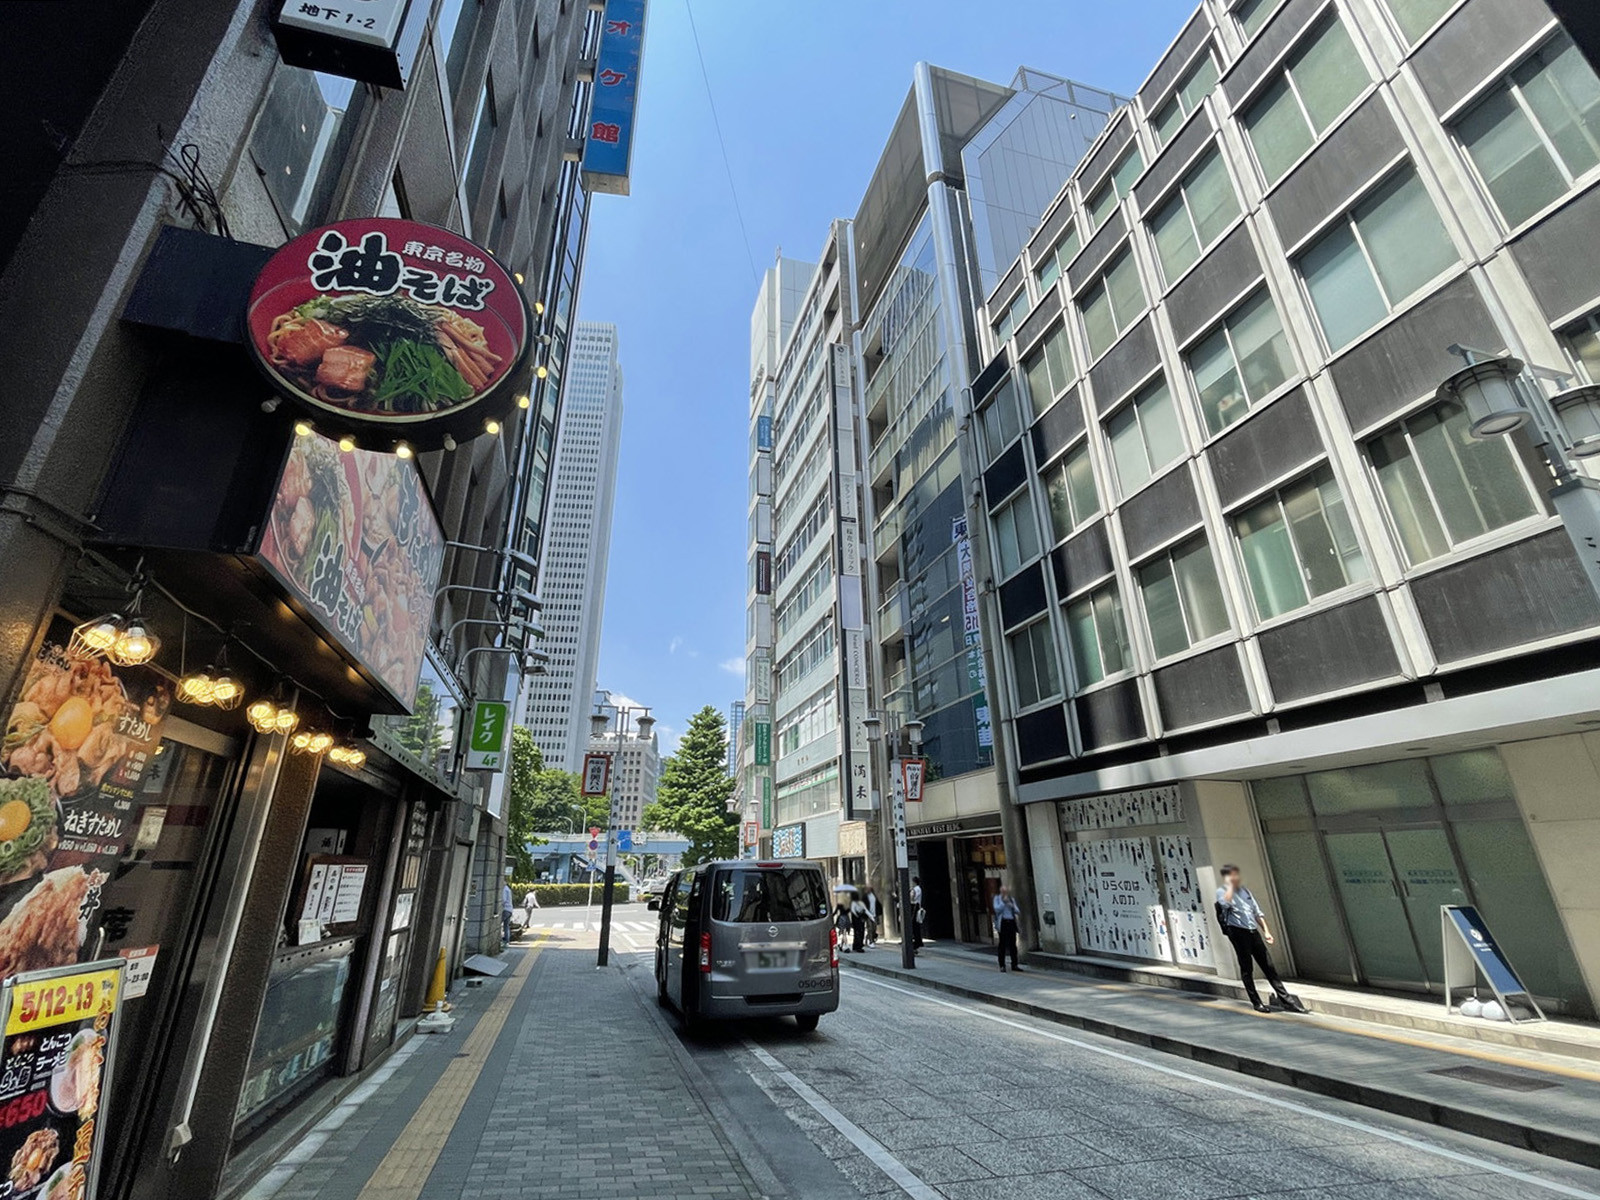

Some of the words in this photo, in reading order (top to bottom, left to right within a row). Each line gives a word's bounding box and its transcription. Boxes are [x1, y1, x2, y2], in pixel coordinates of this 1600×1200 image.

[307, 229, 496, 312] 油そば
[402, 240, 486, 274] 東京名物
[118, 712, 154, 742] すためし
[479, 707, 497, 744] レイク
[481, 754, 498, 767] 4F
[64, 809, 122, 839] ねぎすためし
[1102, 880, 1145, 891] ひらくのは、
[1112, 894, 1140, 905] 人の力。
[40, 1033, 73, 1051] とんこつ
